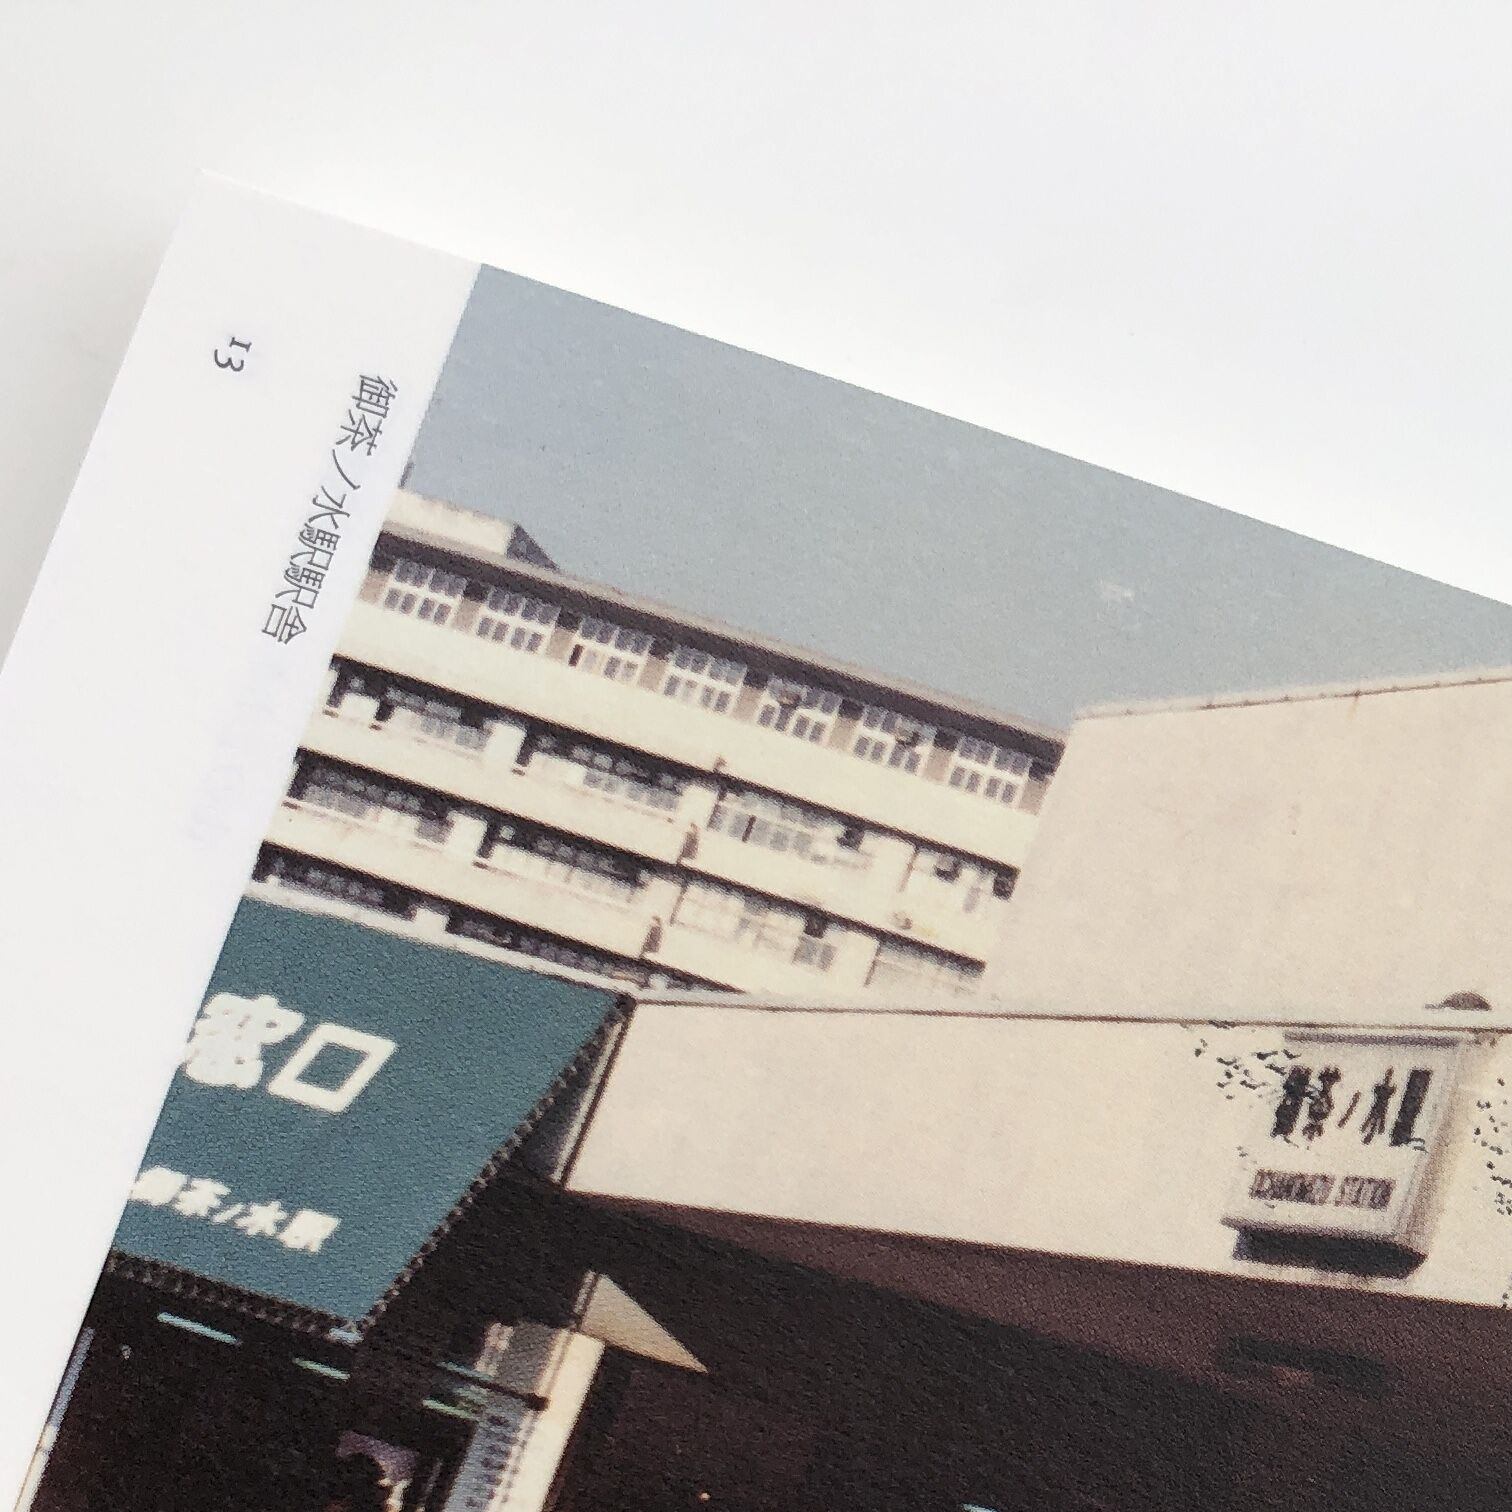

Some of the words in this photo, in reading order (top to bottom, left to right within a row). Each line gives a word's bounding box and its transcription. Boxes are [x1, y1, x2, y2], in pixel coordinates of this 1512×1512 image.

[213, 336, 253, 373] 13
[261, 373, 399, 646] 御茶ノ水駅駅舎
